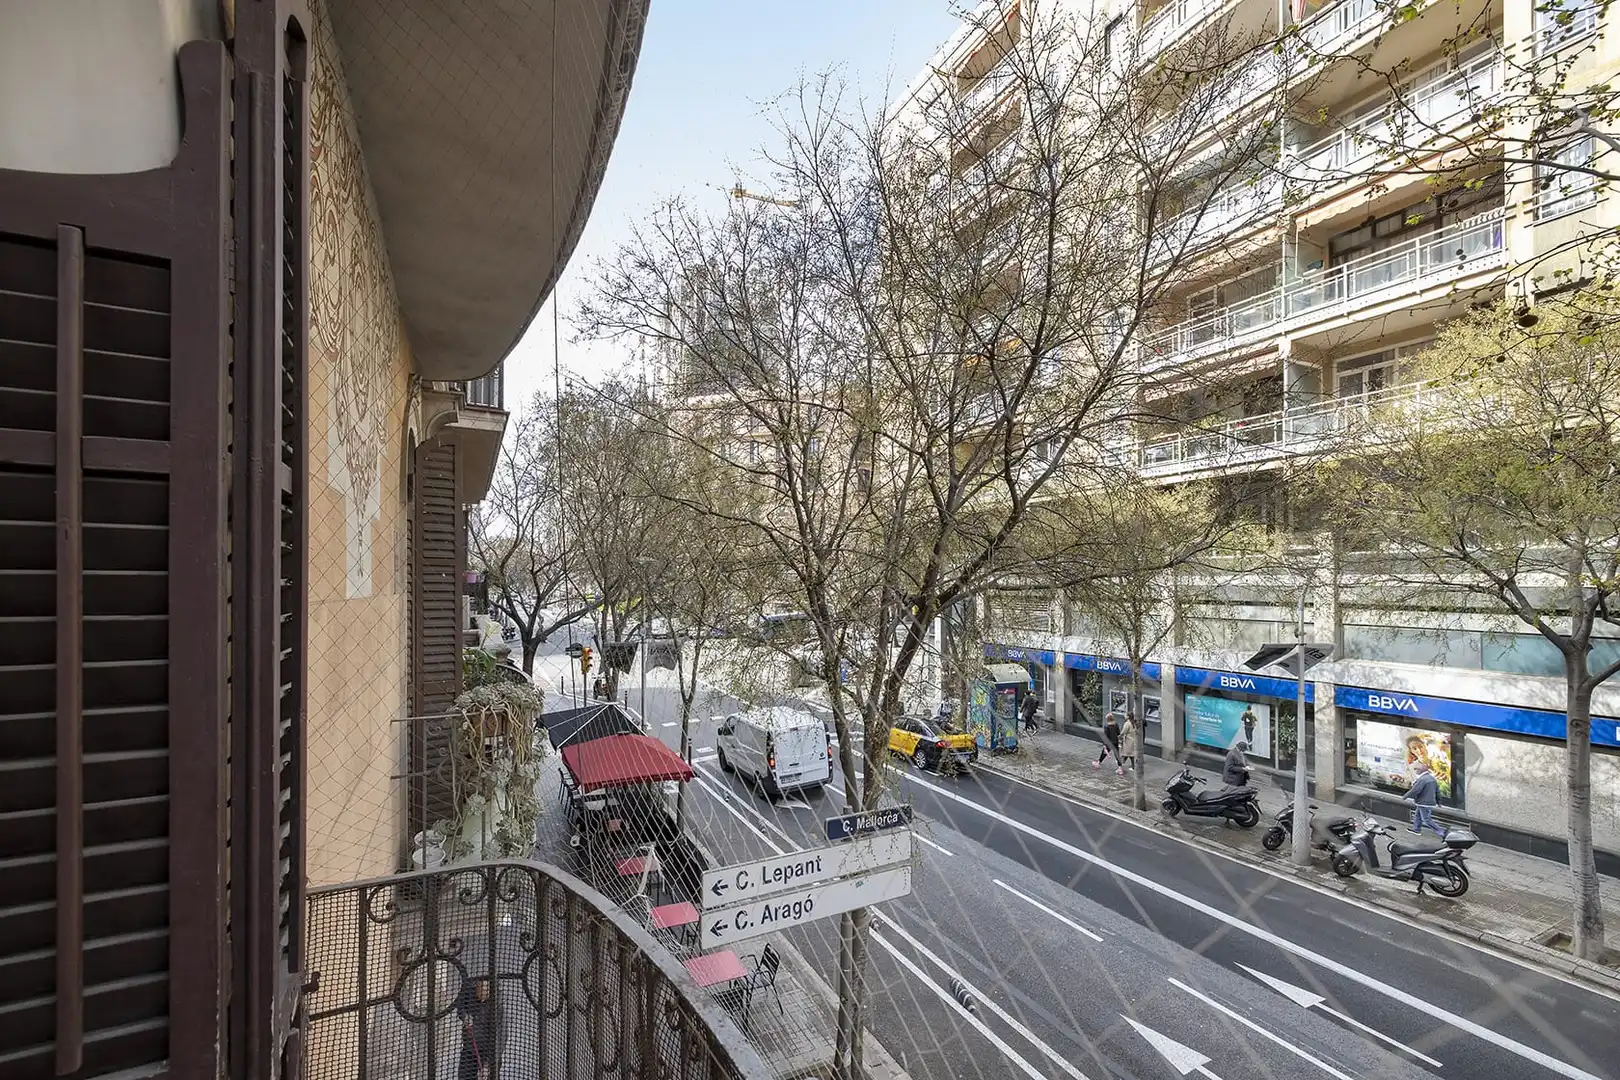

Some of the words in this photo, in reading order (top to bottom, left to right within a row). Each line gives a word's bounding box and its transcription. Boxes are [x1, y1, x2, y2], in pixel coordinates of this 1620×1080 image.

[1096, 661, 1122, 671] BBVA
[1220, 676, 1256, 690] BBVA
[1368, 694, 1419, 712] BBVA
[842, 820, 854, 832] C.
[856, 812, 899, 829] Mallorca
[735, 870, 755, 890] C.
[762, 855, 822, 884] Lepant
[735, 910, 754, 929] C.
[761, 894, 814, 925] Aragó
